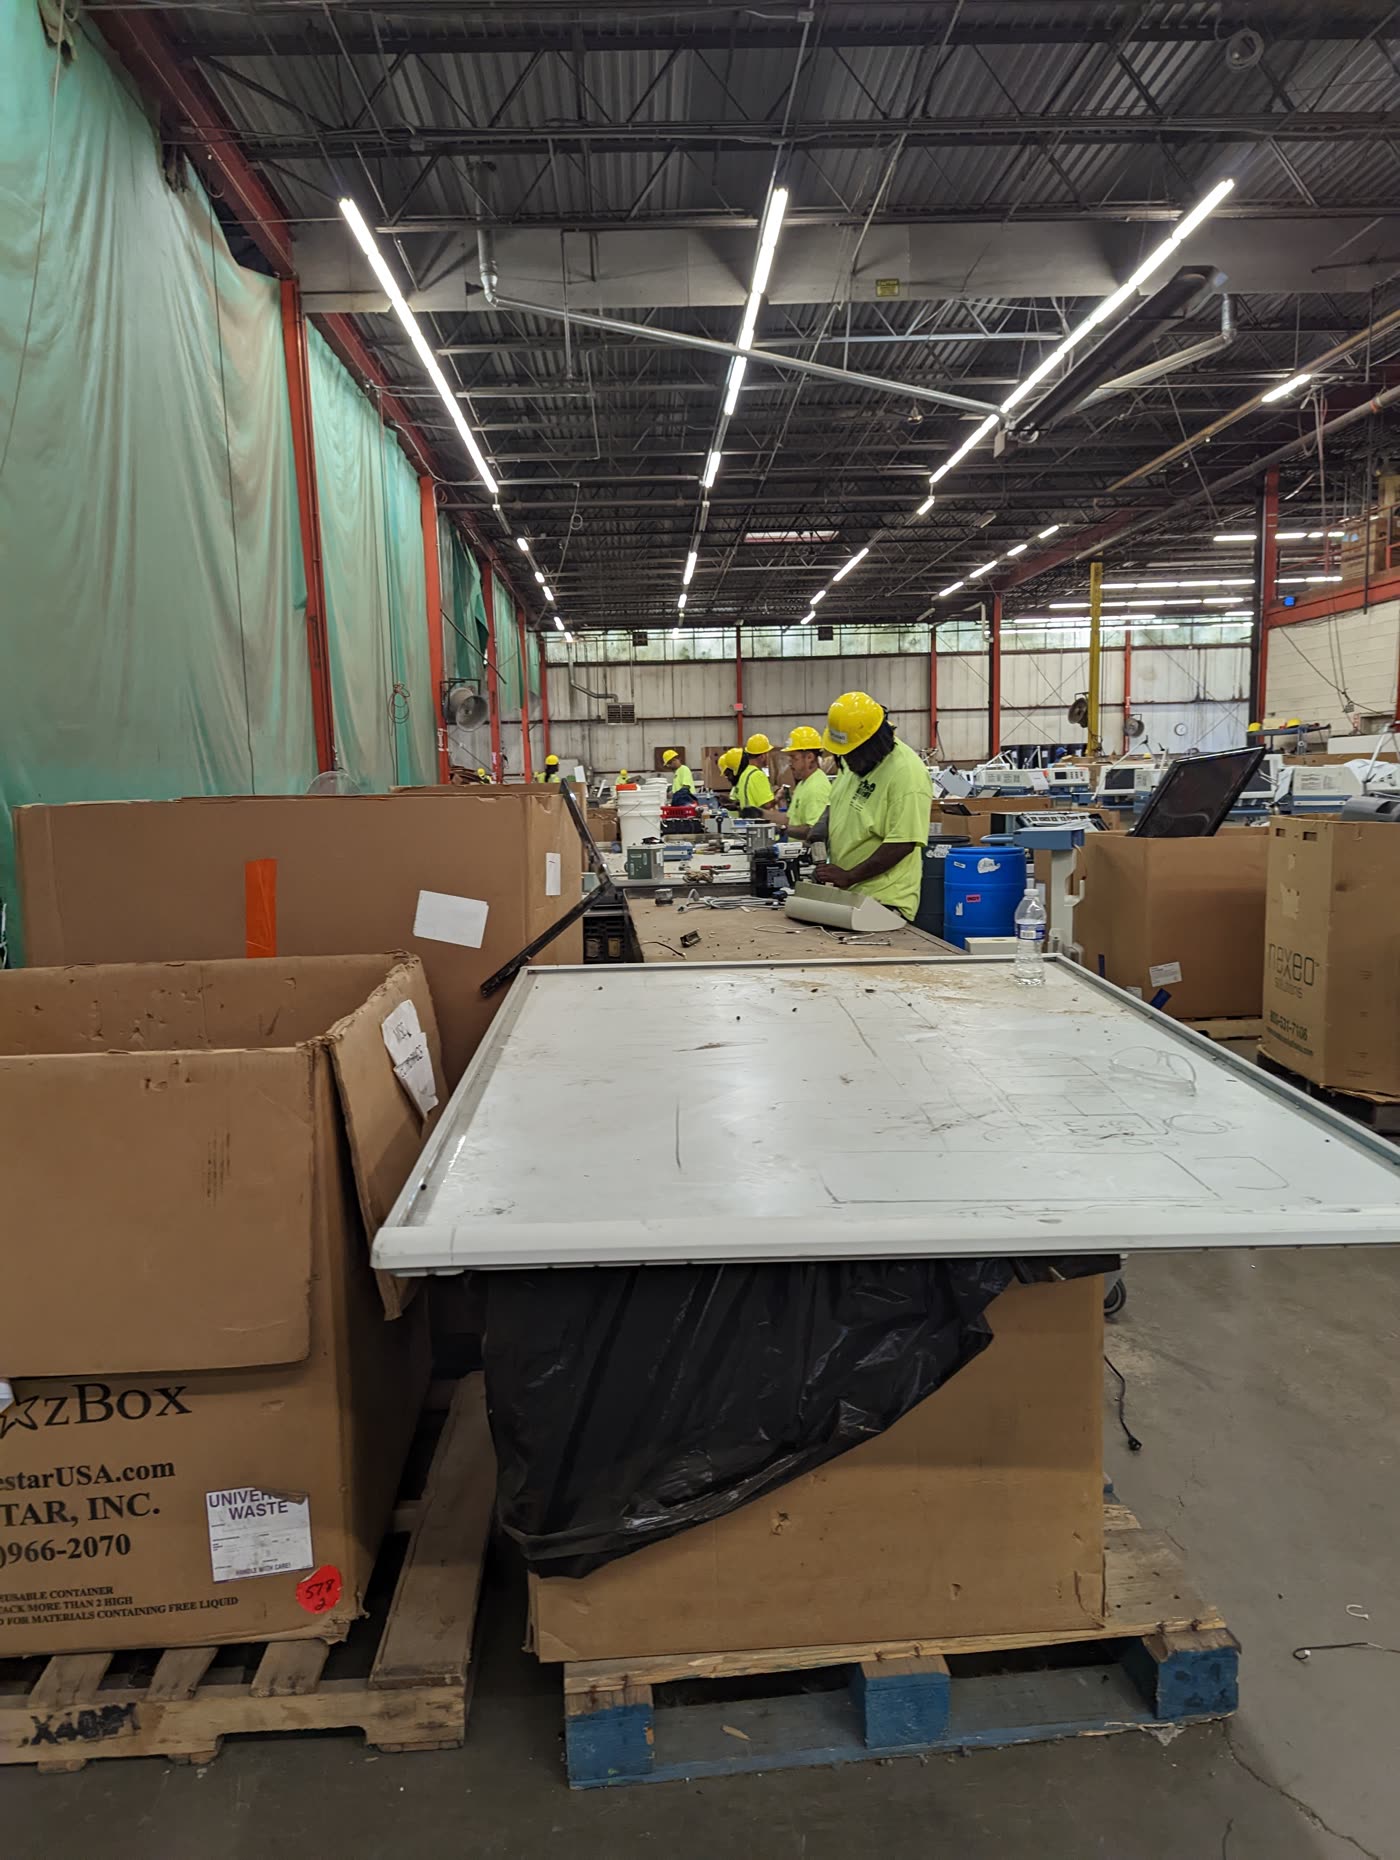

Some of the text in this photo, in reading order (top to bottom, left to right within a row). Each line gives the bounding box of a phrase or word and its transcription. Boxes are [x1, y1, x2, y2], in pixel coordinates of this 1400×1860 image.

[1268, 943, 1315, 986] nexeo
[86, 1492, 161, 1521] INC.
[209, 1490, 272, 1508] UNIVE
[228, 1501, 289, 1520] WASTE
[49, 1586, 114, 1600] CONTAINER
[7, 1615, 30, 1626] FOR
[32, 1610, 95, 1624] MATERIALS
[97, 1604, 166, 1619] CONTAINING
[168, 1601, 197, 1613] FREE
[199, 1596, 239, 1610] LIQUID
[28, 1601, 61, 1612] MORE
[63, 1599, 94, 1610] THAN
[104, 1595, 133, 1606] HIGH
